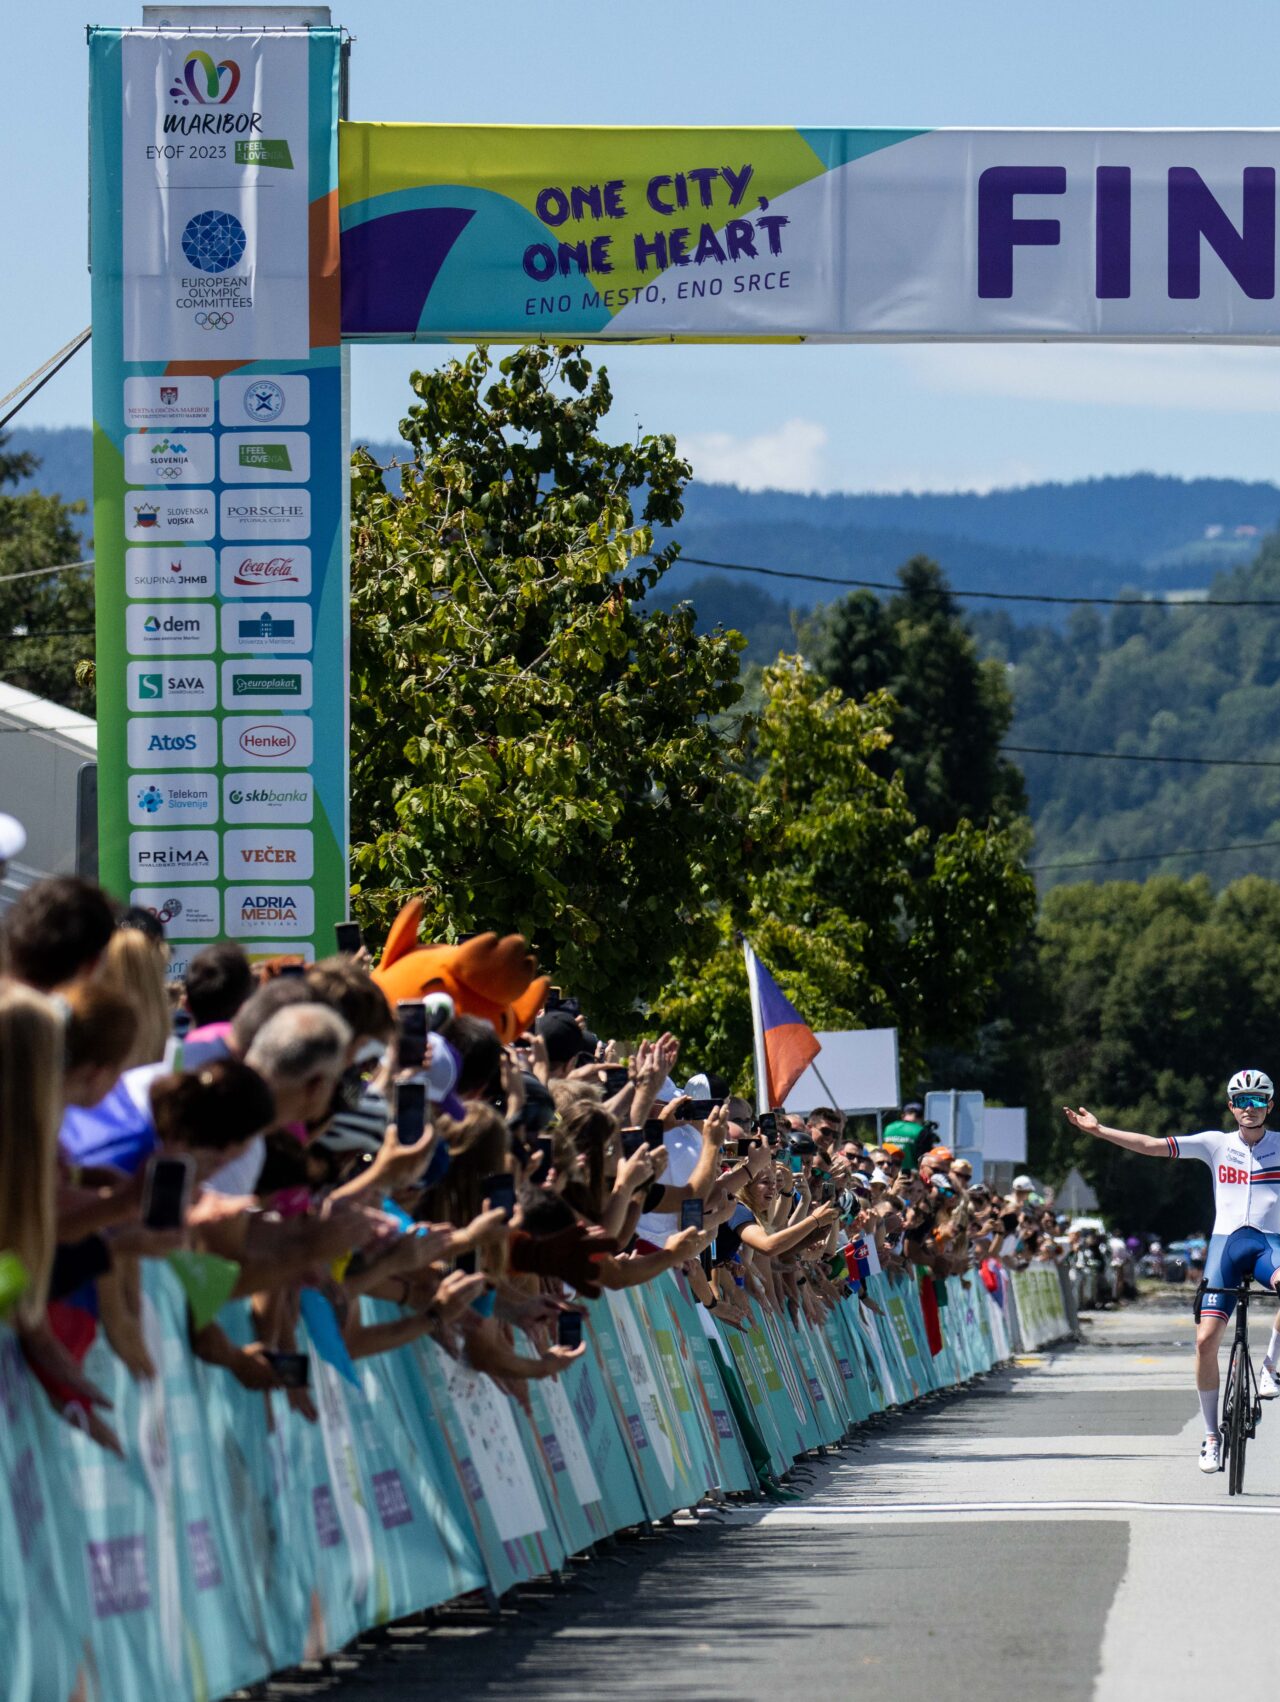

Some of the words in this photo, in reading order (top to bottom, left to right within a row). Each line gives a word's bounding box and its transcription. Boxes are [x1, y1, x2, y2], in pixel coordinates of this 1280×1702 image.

[163, 112, 263, 136] MARIBOR
[244, 142, 265, 151] FEEL
[146, 146, 185, 160] EYOF
[190, 145, 227, 159] 2023
[535, 179, 628, 227] ONE
[646, 164, 769, 216] CITY,
[522, 235, 615, 282] ONE
[633, 215, 791, 274] HEART
[181, 277, 248, 288] EUROPEAN
[188, 288, 240, 299] OLYMPIC
[525, 295, 572, 315] ENO
[581, 284, 667, 311] MESTO,
[677, 278, 723, 300] ENO
[733, 271, 791, 293] SRCE
[175, 298, 253, 309] COMMITTEES
[246, 446, 267, 455] FEEL
[167, 508, 209, 516] SLOVENSKA
[227, 506, 304, 516] PORSCHE
[167, 517, 194, 526] VOJSKA
[239, 557, 295, 576] Coca-Cola
[134, 576, 176, 584] SKUPINA
[178, 575, 207, 584] JHMB
[163, 616, 200, 632] dem
[168, 677, 205, 689] SAVA
[247, 678, 296, 689] europlakat
[245, 735, 291, 747] Henkel
[168, 789, 208, 799] Telekom
[168, 799, 208, 809] Slovenije
[241, 845, 297, 863] VEČER
[242, 896, 297, 908] ADRIA
[241, 909, 297, 920] MEDIA
[1218, 1164, 1249, 1185] GBR
